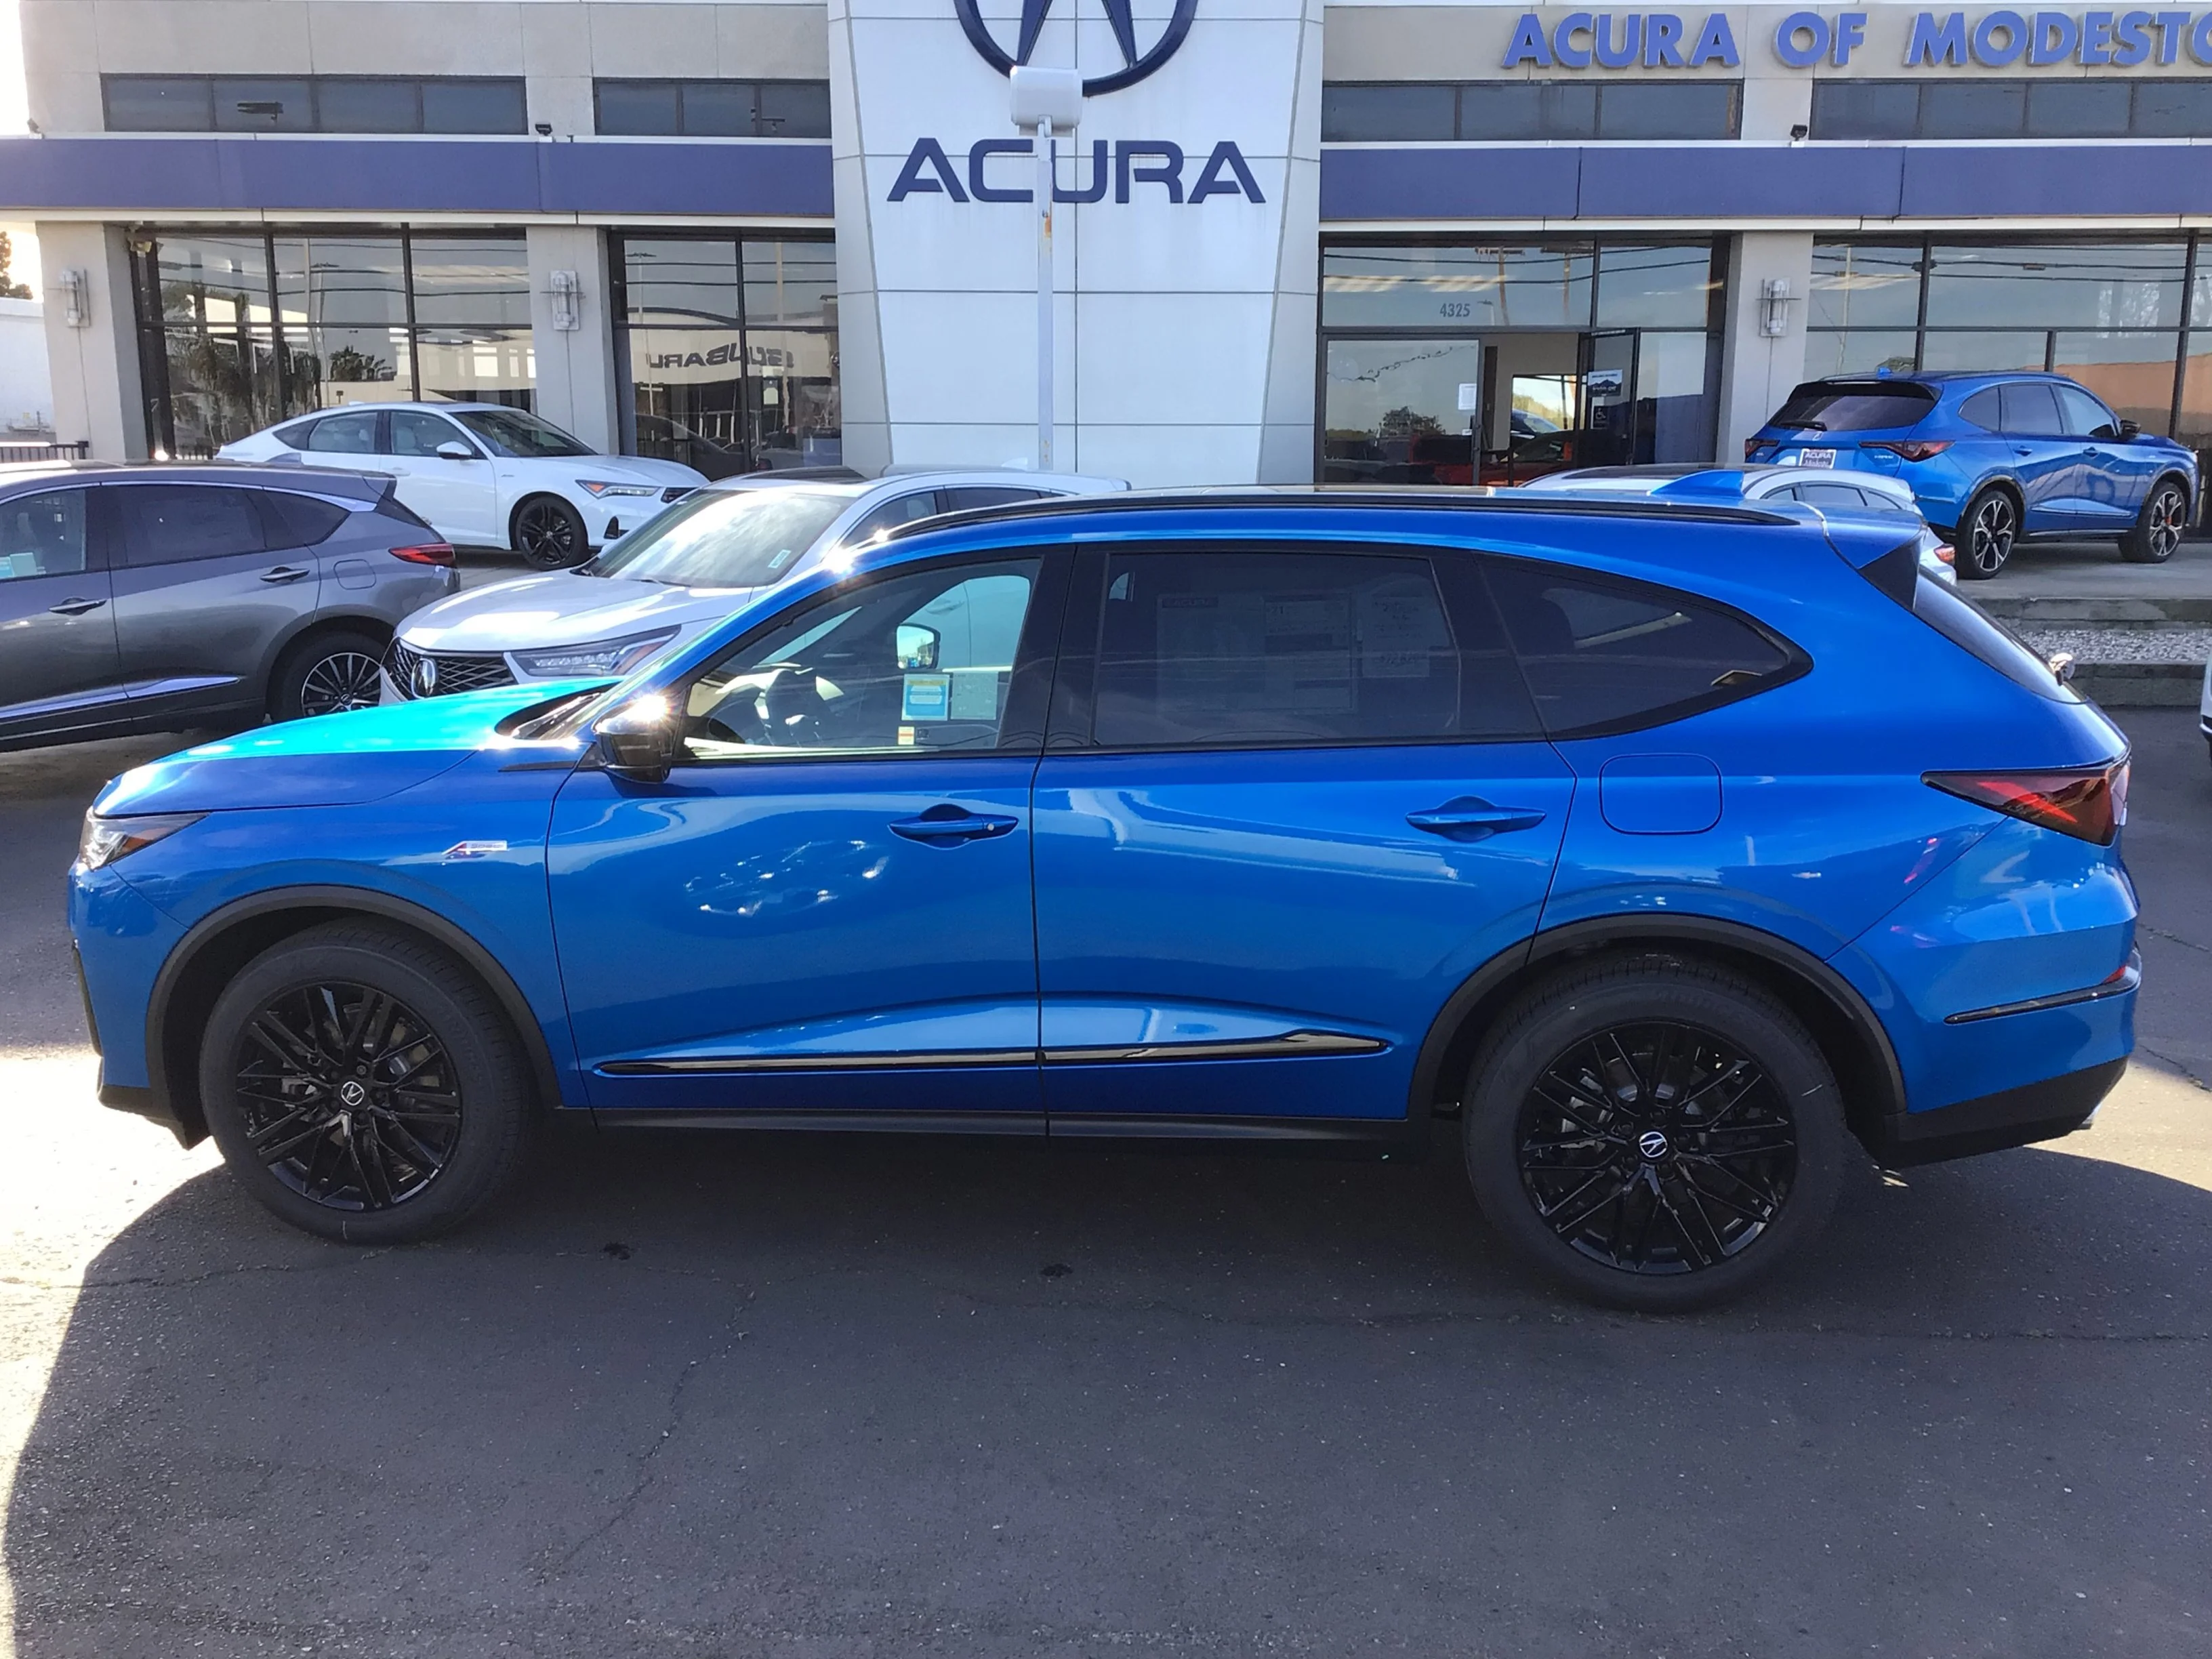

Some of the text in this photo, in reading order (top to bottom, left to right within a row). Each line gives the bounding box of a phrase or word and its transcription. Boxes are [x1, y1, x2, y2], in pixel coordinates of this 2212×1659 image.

[1502, 12, 1740, 68] ACURA
[1775, 11, 1868, 67] OF
[886, 138, 1267, 204] ACURA
[1439, 302, 1471, 318] 4325
